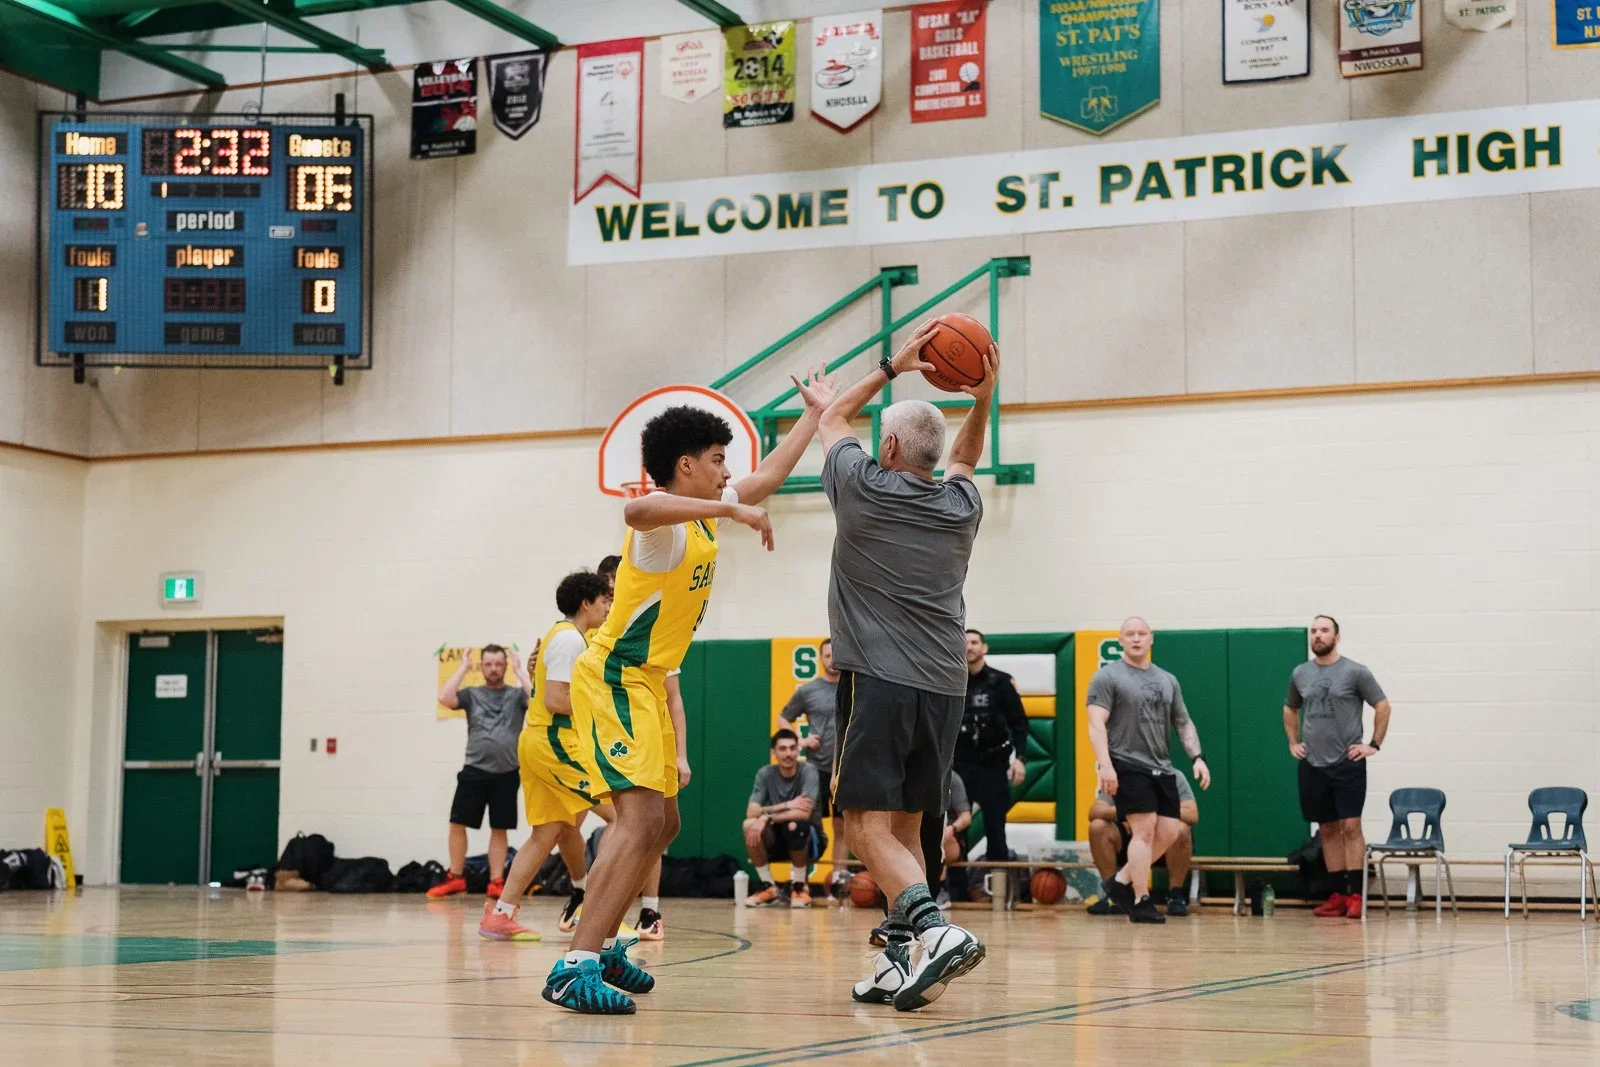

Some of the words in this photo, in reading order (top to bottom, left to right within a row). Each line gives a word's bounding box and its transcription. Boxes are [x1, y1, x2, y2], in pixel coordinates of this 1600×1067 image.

[1060, 6, 1138, 25] CHAMPIONS
[1056, 29, 1083, 47] ST.
[1088, 23, 1141, 44] PAT'S
[919, 41, 979, 60] BASKETBALL
[1059, 49, 1139, 67] WRESTLING
[1353, 57, 1410, 71] NWOSSAA
[66, 132, 116, 155] Home
[174, 129, 270, 175] 2:32
[289, 134, 351, 157] Guests
[596, 188, 848, 242] WELCOME
[878, 181, 944, 222] TO
[995, 171, 1075, 215] ST.
[1099, 143, 1352, 205] PATRICK
[1411, 125, 1563, 179] HIGH
[176, 210, 235, 233] period
[69, 246, 112, 267] fouls
[176, 245, 235, 269] player
[298, 247, 341, 269] fouls
[98, 278, 108, 311] 1
[313, 279, 336, 313] 0
[74, 326, 108, 341] won
[302, 326, 337, 342] won
